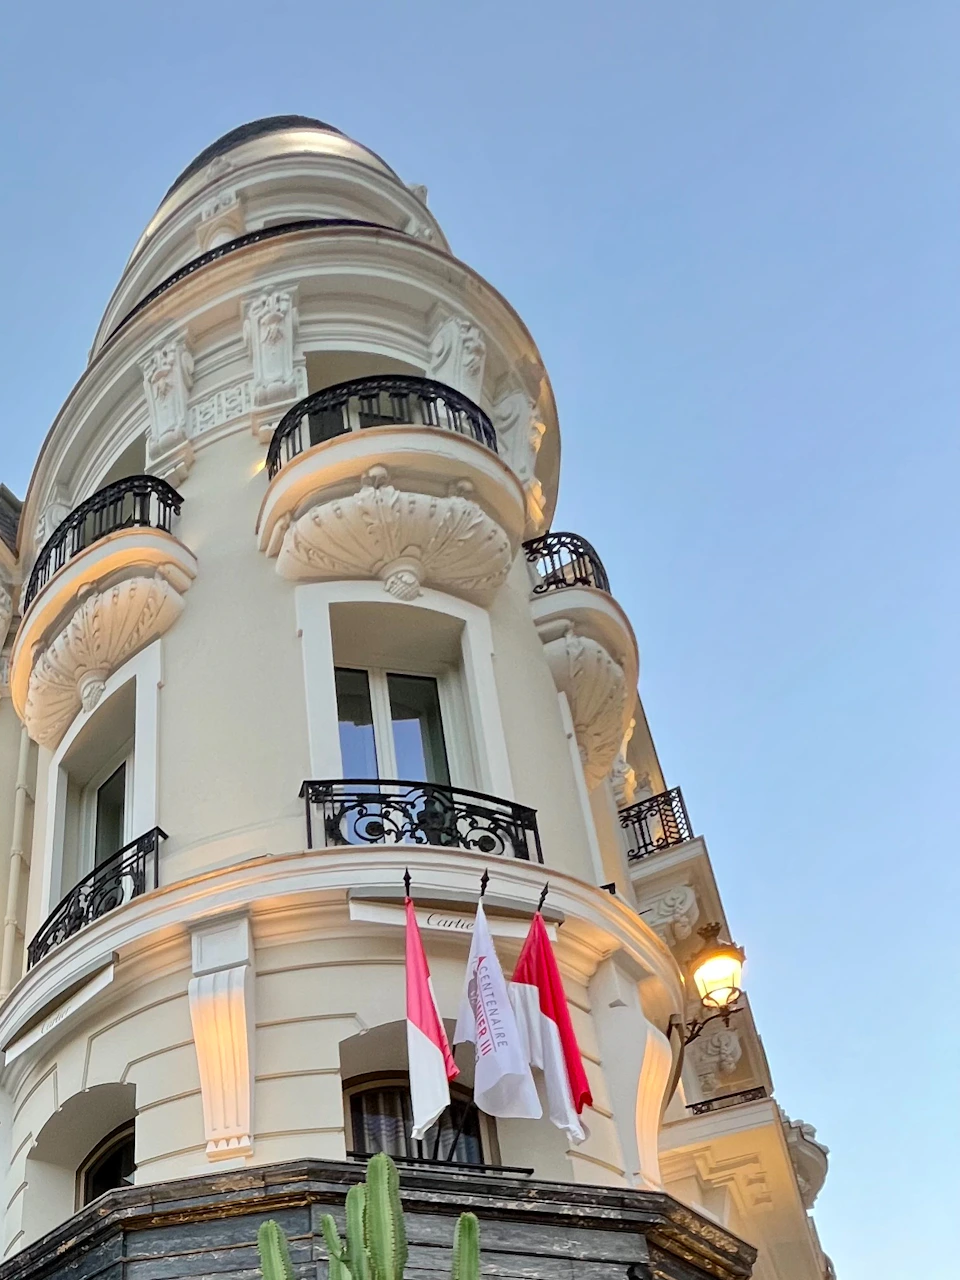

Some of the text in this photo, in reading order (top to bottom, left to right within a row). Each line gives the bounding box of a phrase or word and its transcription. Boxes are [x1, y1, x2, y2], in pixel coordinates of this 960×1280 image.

[427, 912, 474, 930] Cartie
[479, 965, 509, 1048] CENTENAIRE
[480, 1039, 492, 1056] III
